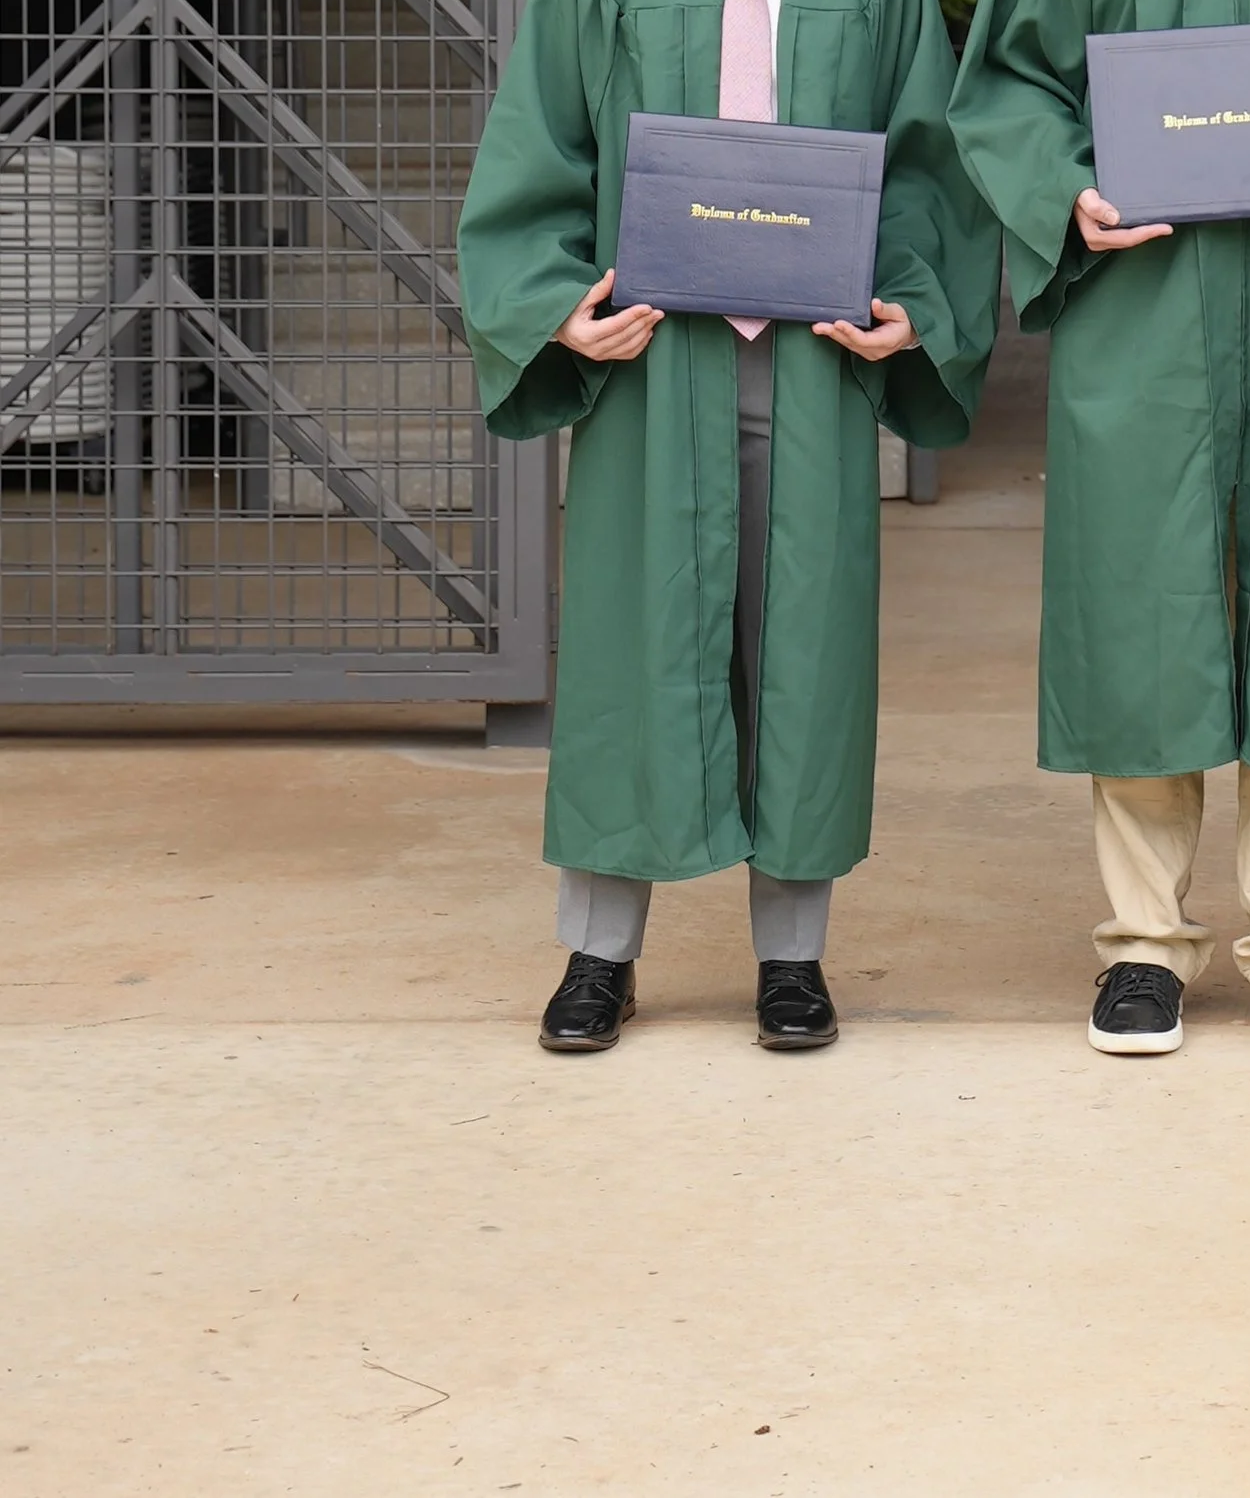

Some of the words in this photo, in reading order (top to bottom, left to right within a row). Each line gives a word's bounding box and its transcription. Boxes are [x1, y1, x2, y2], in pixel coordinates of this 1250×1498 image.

[1162, 114, 1208, 130] Diploma
[1209, 112, 1222, 125] of
[690, 203, 735, 221] Diploma
[737, 209, 750, 221] of
[750, 209, 811, 226] Graduation
